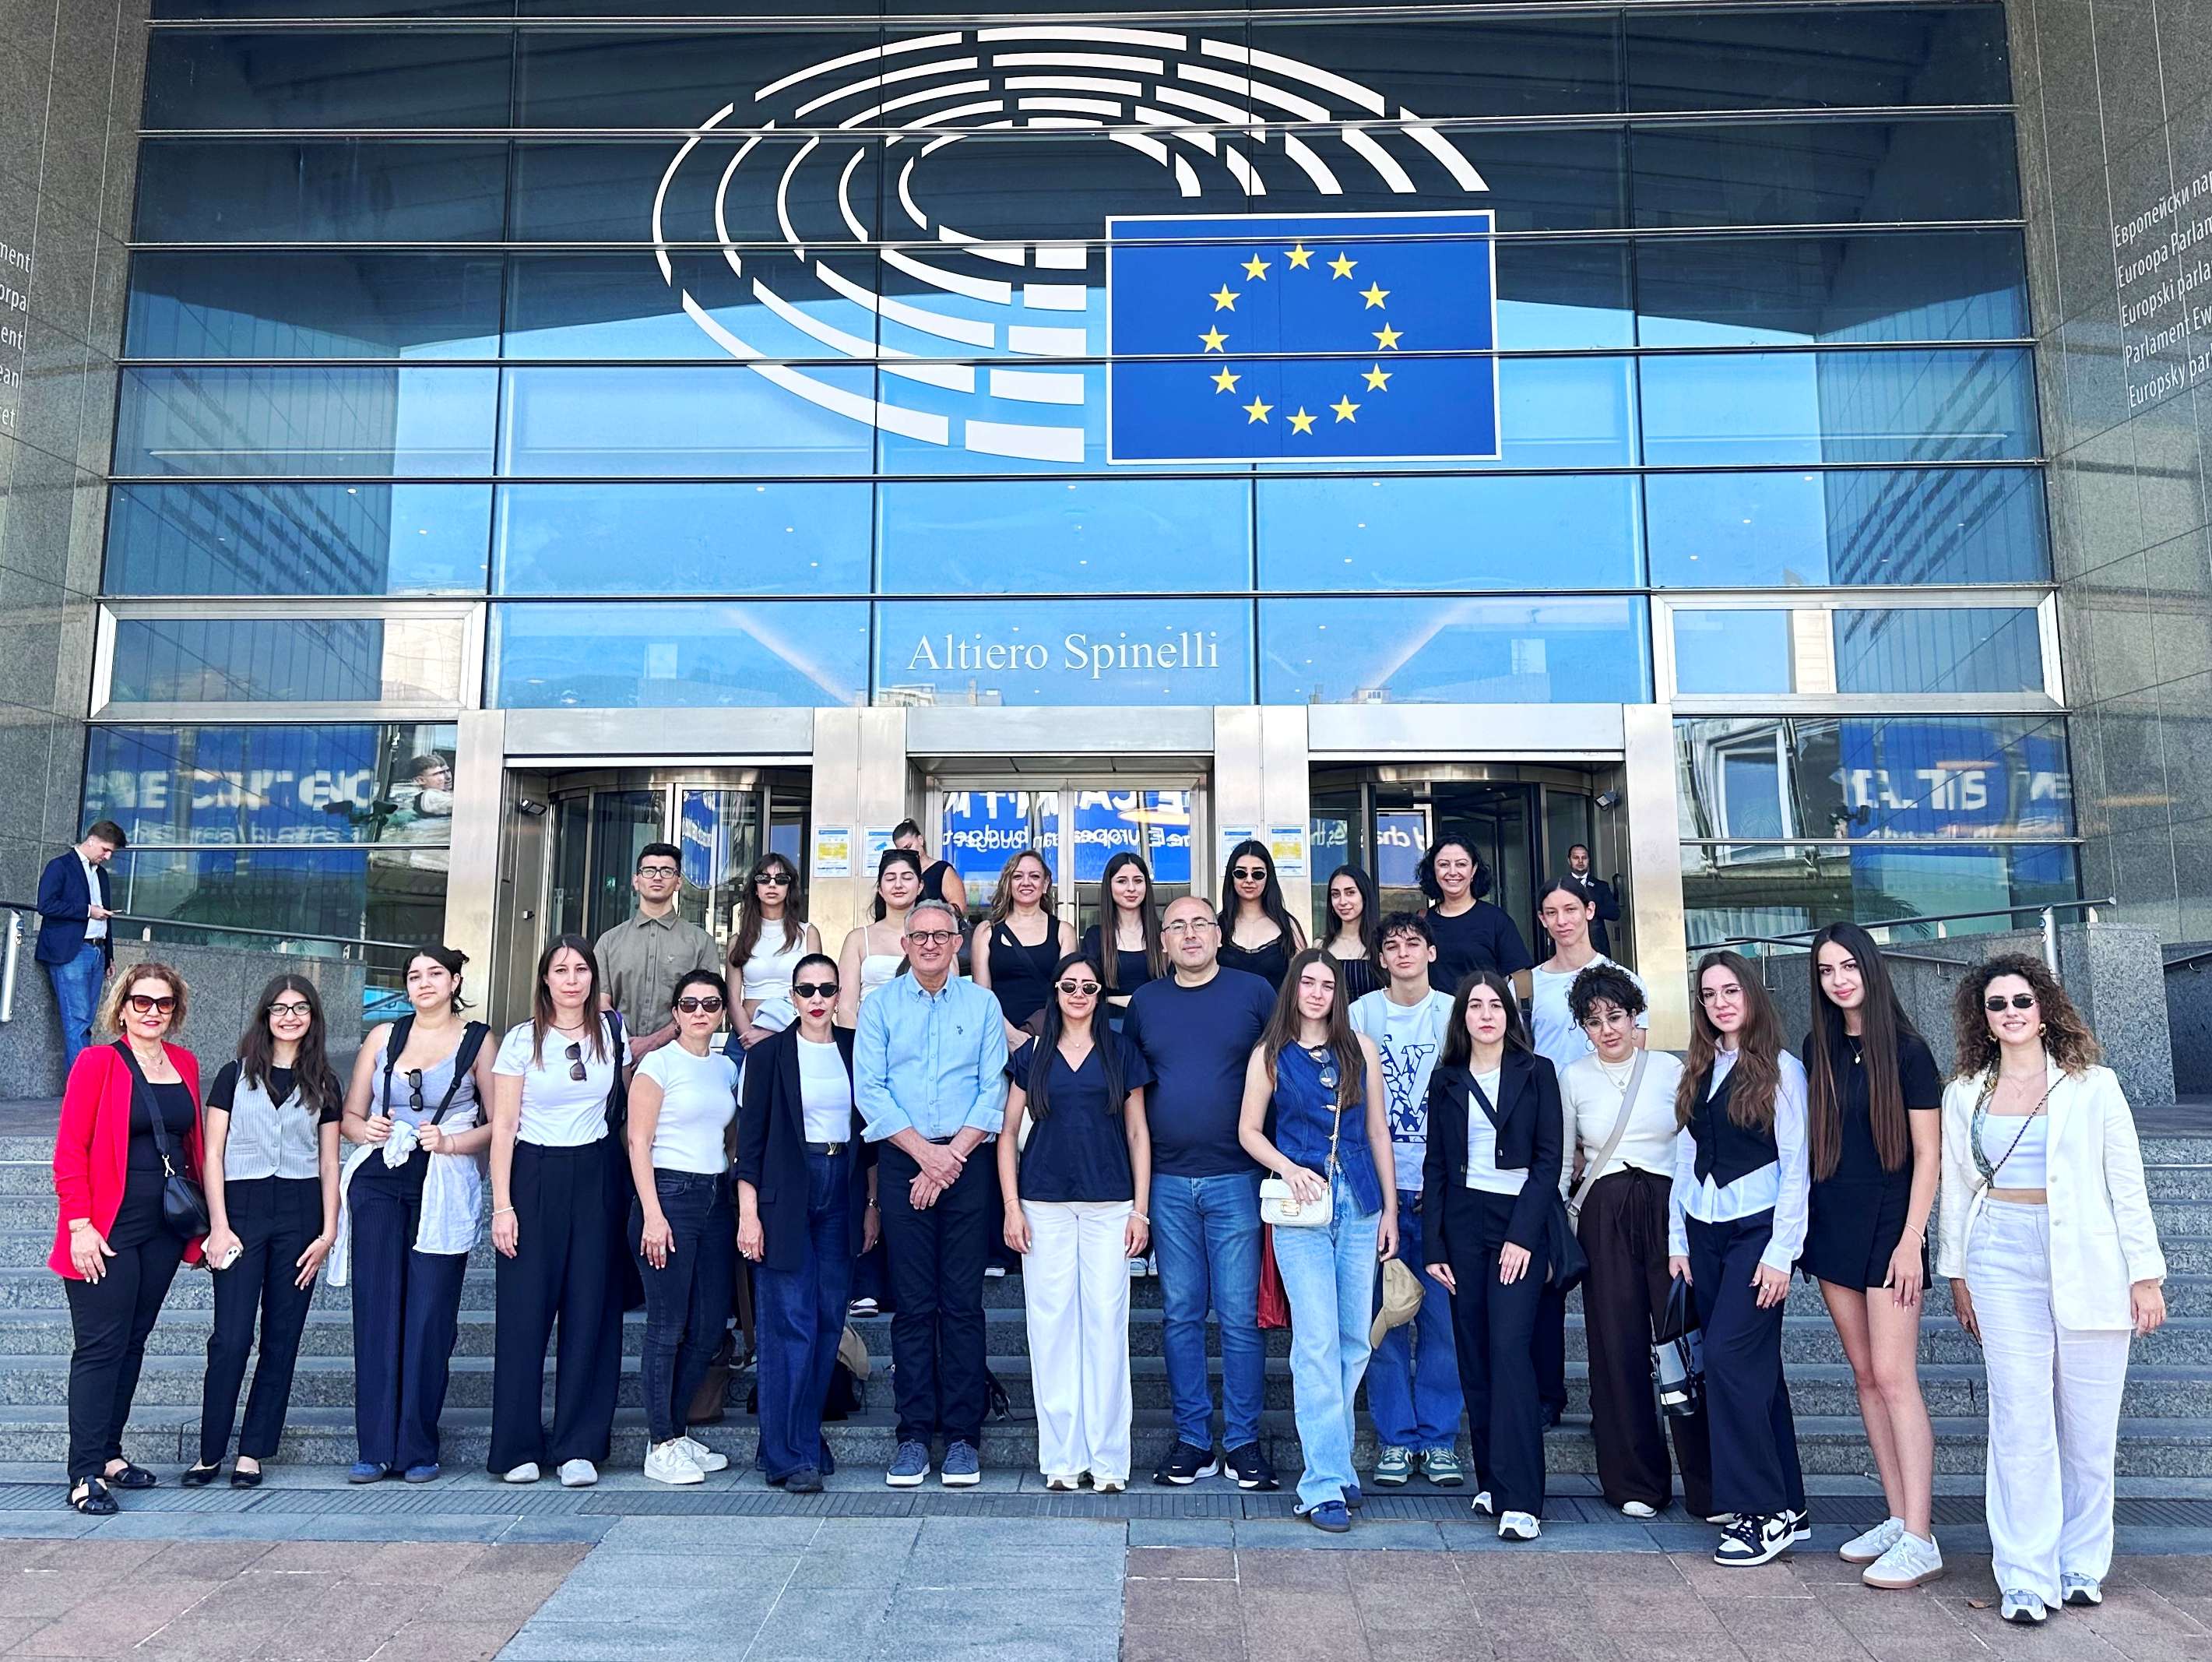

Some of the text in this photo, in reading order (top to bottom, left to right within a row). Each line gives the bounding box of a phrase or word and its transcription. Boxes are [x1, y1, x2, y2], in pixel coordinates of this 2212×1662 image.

[2114, 186, 2190, 248] Европейски
[2118, 245, 2168, 288] Euroopa
[2122, 260, 2212, 327] Europski parla
[2125, 305, 2212, 368] Parlament Ew
[2129, 364, 2186, 408] Európsky
[0, 407, 16, 428] et
[906, 631, 1220, 680] Altiero Spinelli
